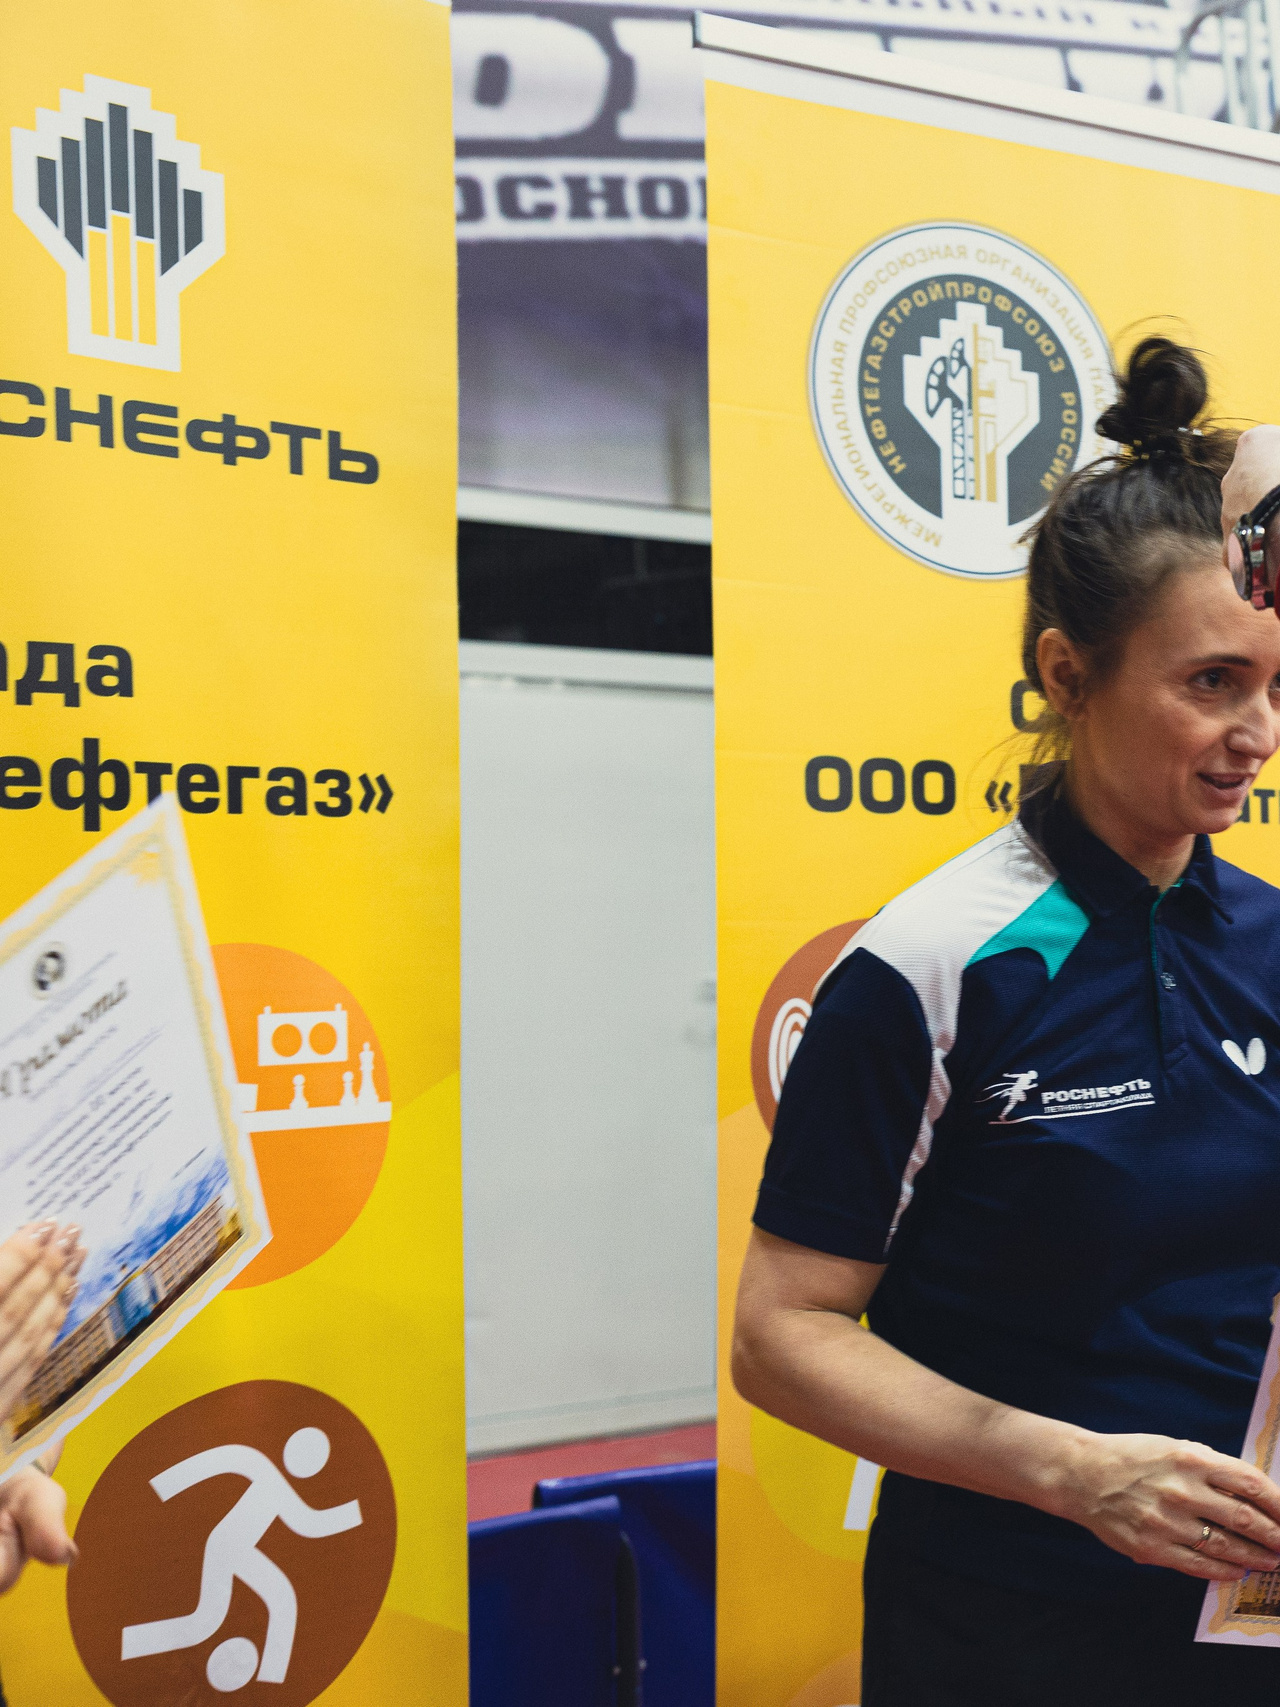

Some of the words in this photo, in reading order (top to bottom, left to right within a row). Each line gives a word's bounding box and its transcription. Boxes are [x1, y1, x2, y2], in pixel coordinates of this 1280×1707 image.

[455, 174, 707, 223] ОСНО
[839, 244, 968, 334] ПРОФСОЮЗНАЯ
[975, 248, 1095, 360] ОРГАНИЗАЦИЯ
[862, 280, 1066, 475] НЕФТЕГАЗСТРОЙПРОФСОЮЗ
[1039, 391, 1078, 492] РОССИИ
[831, 340, 942, 547] МЕЖРЕГИОНАЛЬНАЯ
[804, 755, 957, 816] ООО
[1041, 1078, 1152, 1105] РОСНЕФТЬ
